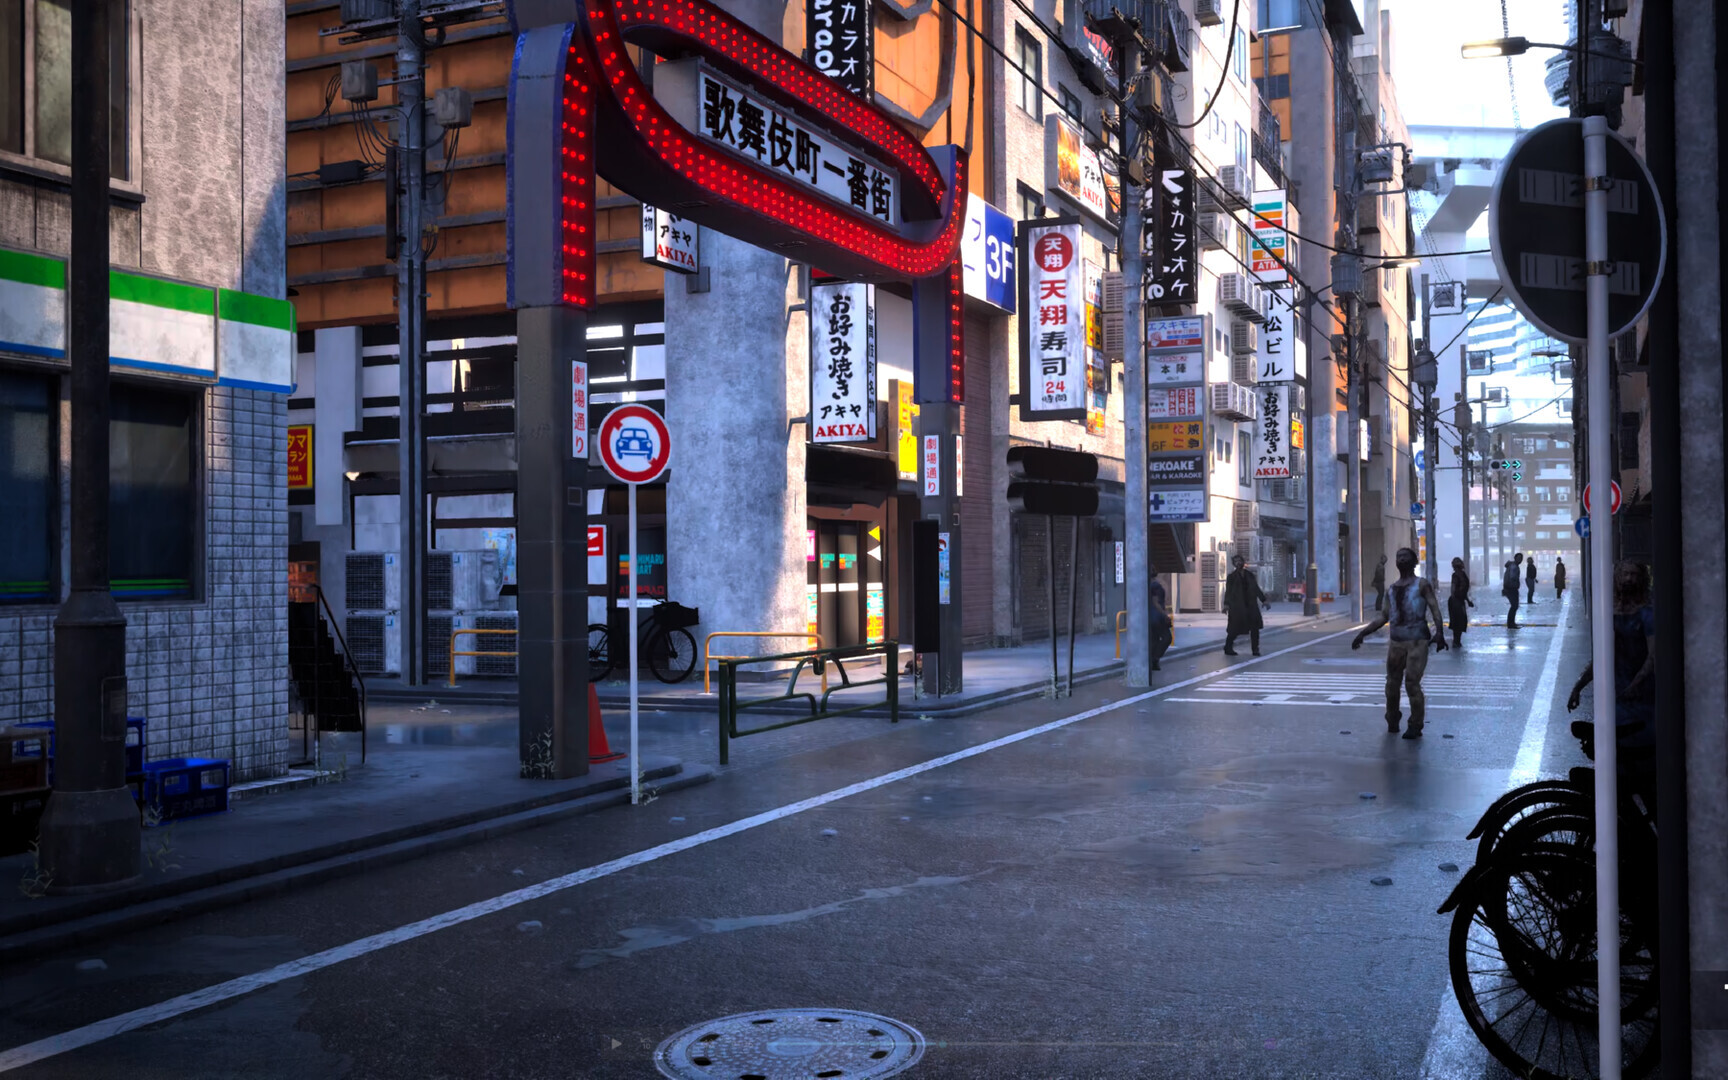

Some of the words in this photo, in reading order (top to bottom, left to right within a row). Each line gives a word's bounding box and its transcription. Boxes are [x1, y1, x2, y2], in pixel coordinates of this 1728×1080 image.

[704, 77, 891, 221] 歌舞伎町一番街
[660, 225, 692, 248] アキヤ
[657, 243, 696, 268] AKIYA
[986, 234, 1013, 284] 3F
[1044, 237, 1063, 268] 天翔
[1171, 210, 1189, 297] カラオケ
[1258, 260, 1278, 270] ATM
[1040, 279, 1068, 376] 天翔寿司
[828, 293, 854, 400] お好み焼き
[1045, 380, 1065, 394] 24
[573, 366, 585, 454] 劇場通り
[820, 404, 862, 419] アキヤ
[1263, 392, 1280, 454] お好み焼き
[815, 424, 867, 438] AKIYA
[1151, 440, 1167, 451] 6F
[926, 438, 938, 493] 劇場通り
[1255, 467, 1289, 476] AKIYA
[1259, 455, 1286, 465] アキヤ
